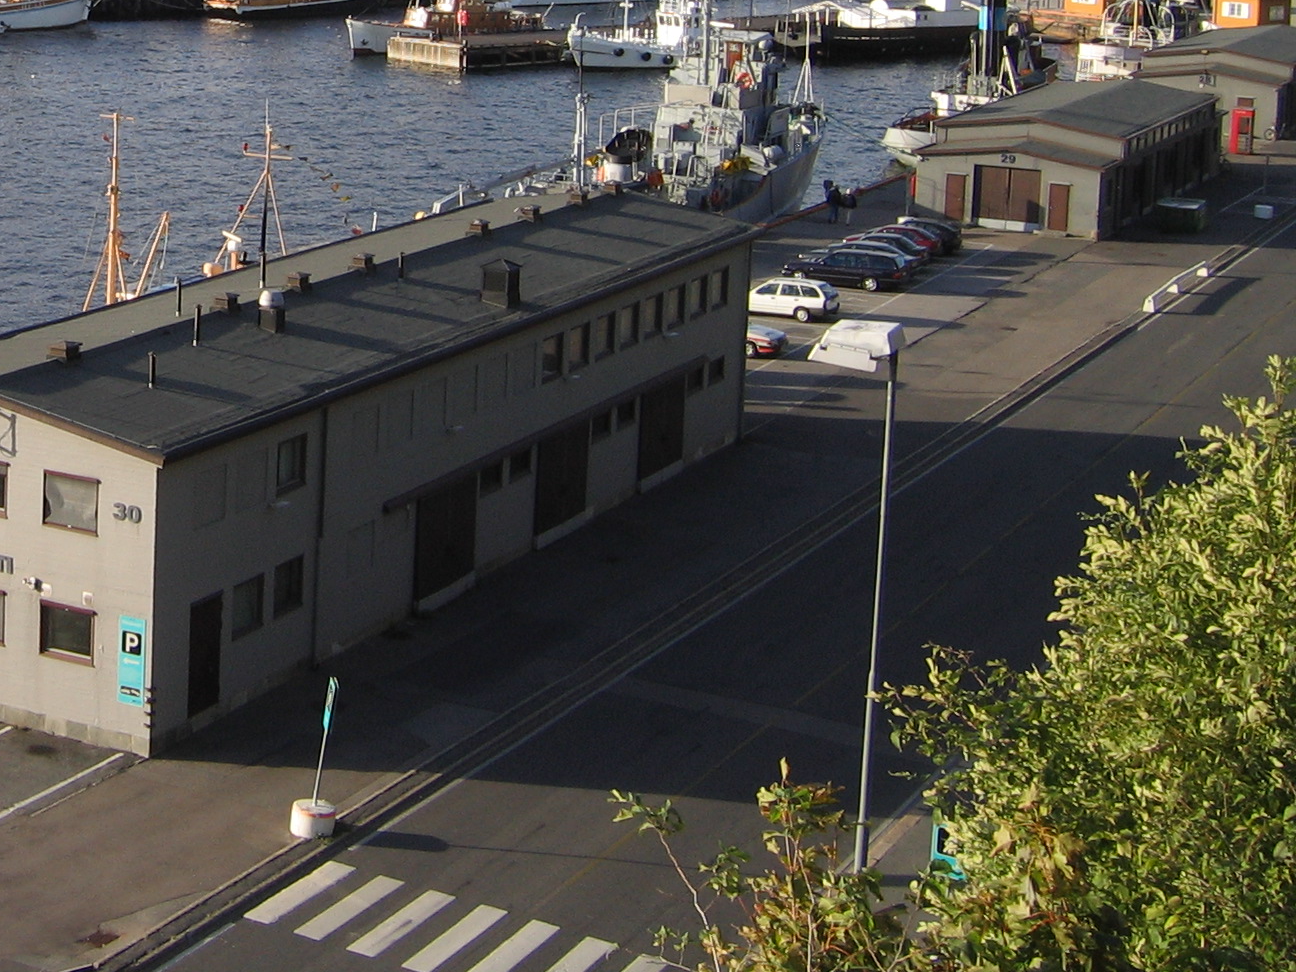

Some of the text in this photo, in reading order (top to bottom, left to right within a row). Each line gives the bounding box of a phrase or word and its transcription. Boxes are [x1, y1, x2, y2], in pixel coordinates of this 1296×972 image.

[1001, 154, 1016, 164] 29
[112, 502, 143, 524] 30
[125, 632, 139, 652] P
